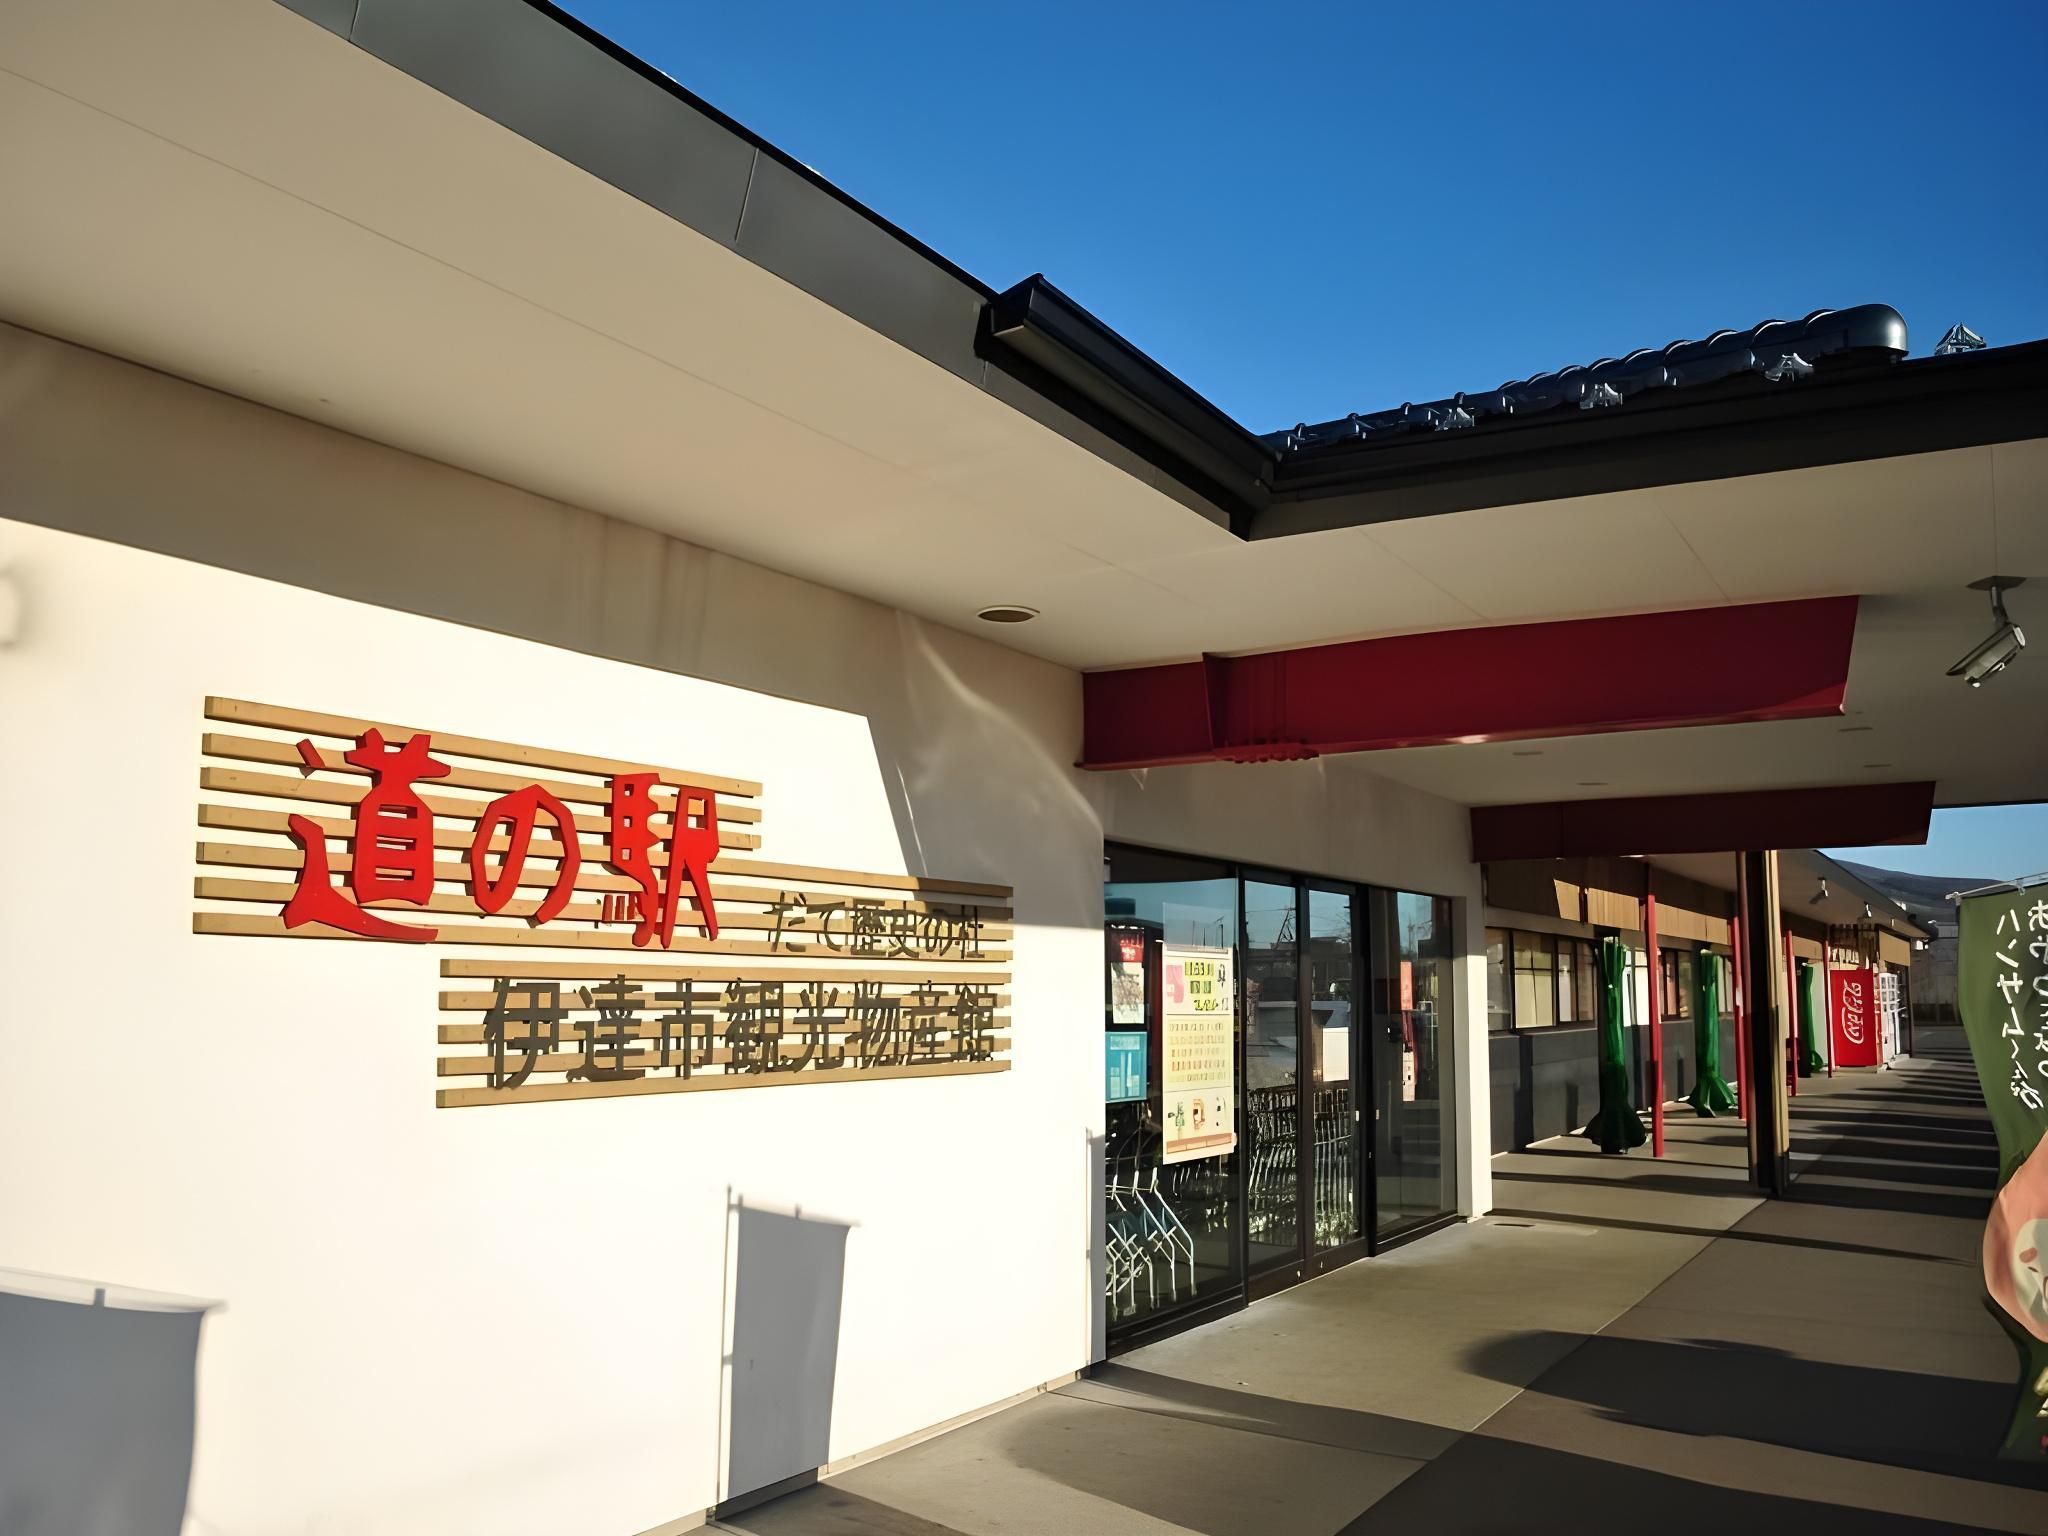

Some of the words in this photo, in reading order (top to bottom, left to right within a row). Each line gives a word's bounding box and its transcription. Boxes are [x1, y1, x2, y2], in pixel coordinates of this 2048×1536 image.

[282, 727, 719, 949] 道の駅
[485, 974, 999, 1090] 伊達市観光物産館
